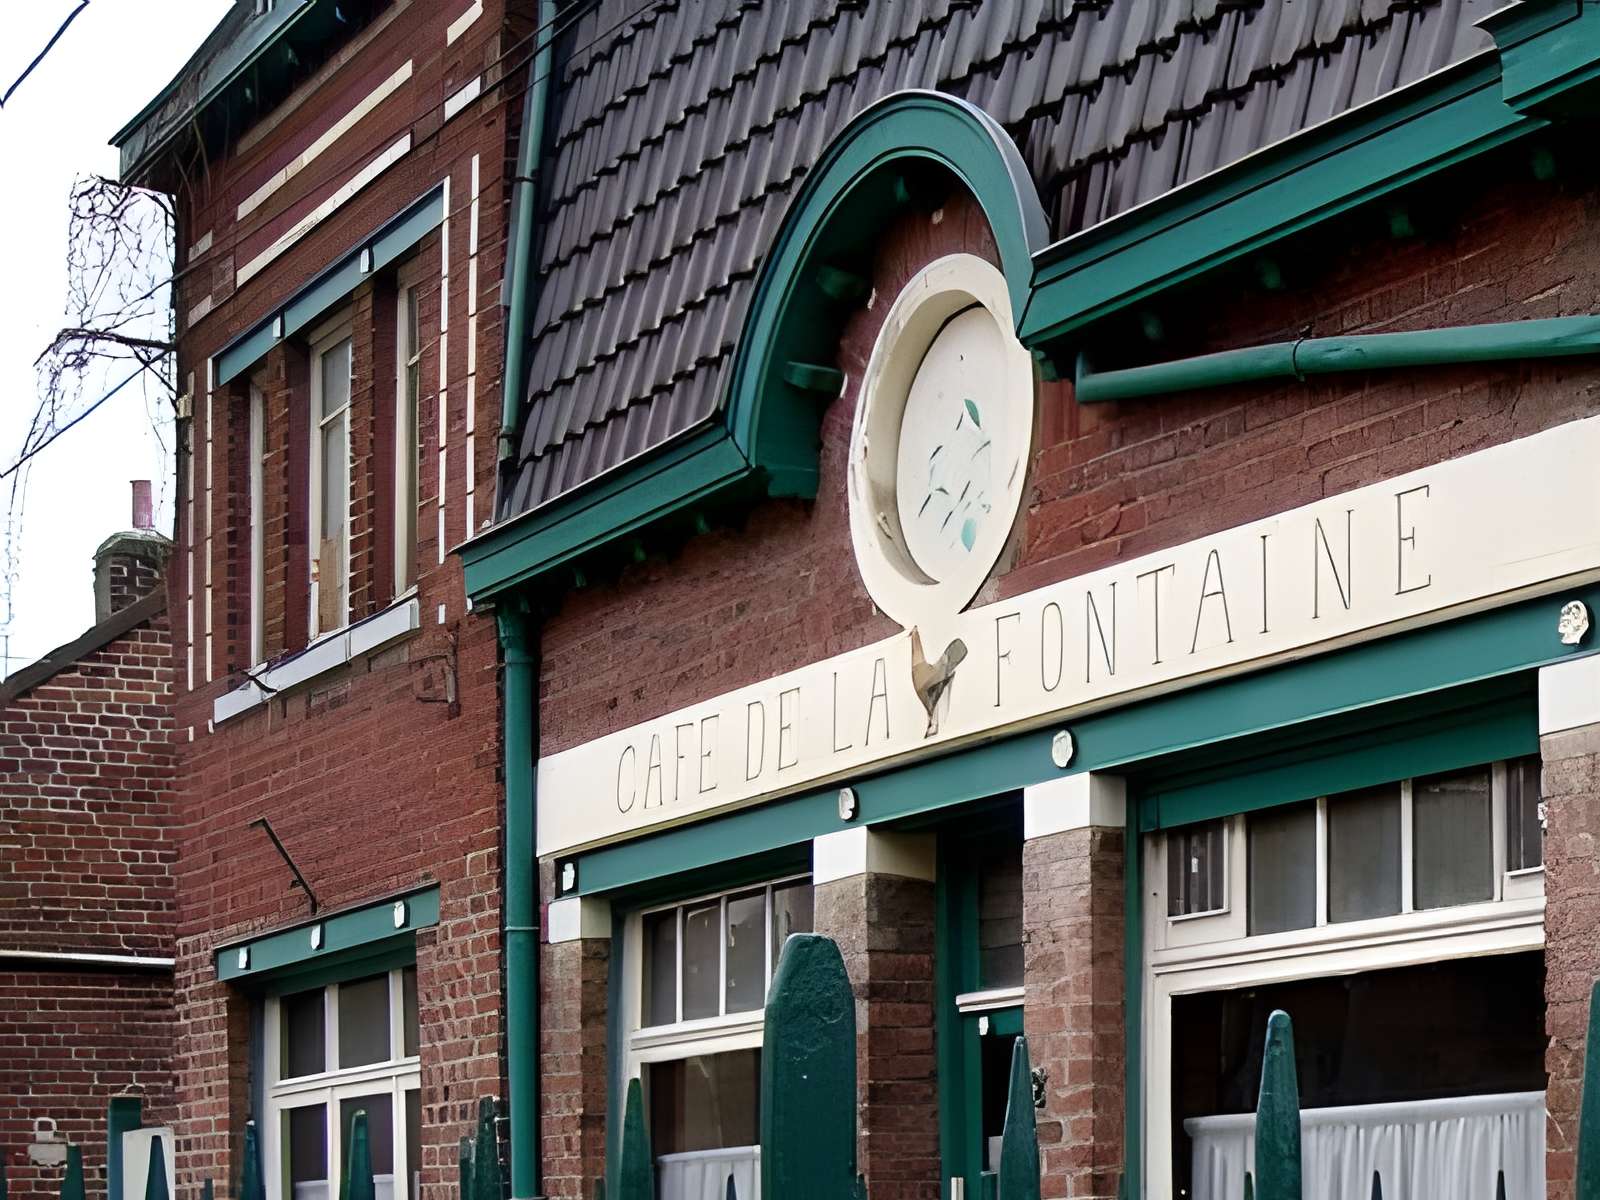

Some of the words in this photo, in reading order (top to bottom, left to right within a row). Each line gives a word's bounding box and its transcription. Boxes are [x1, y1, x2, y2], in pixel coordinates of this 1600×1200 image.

[616, 713, 721, 814] CAFE
[745, 686, 801, 782] DE
[832, 656, 891, 753] LA
[993, 484, 1432, 708] FONTAINE
